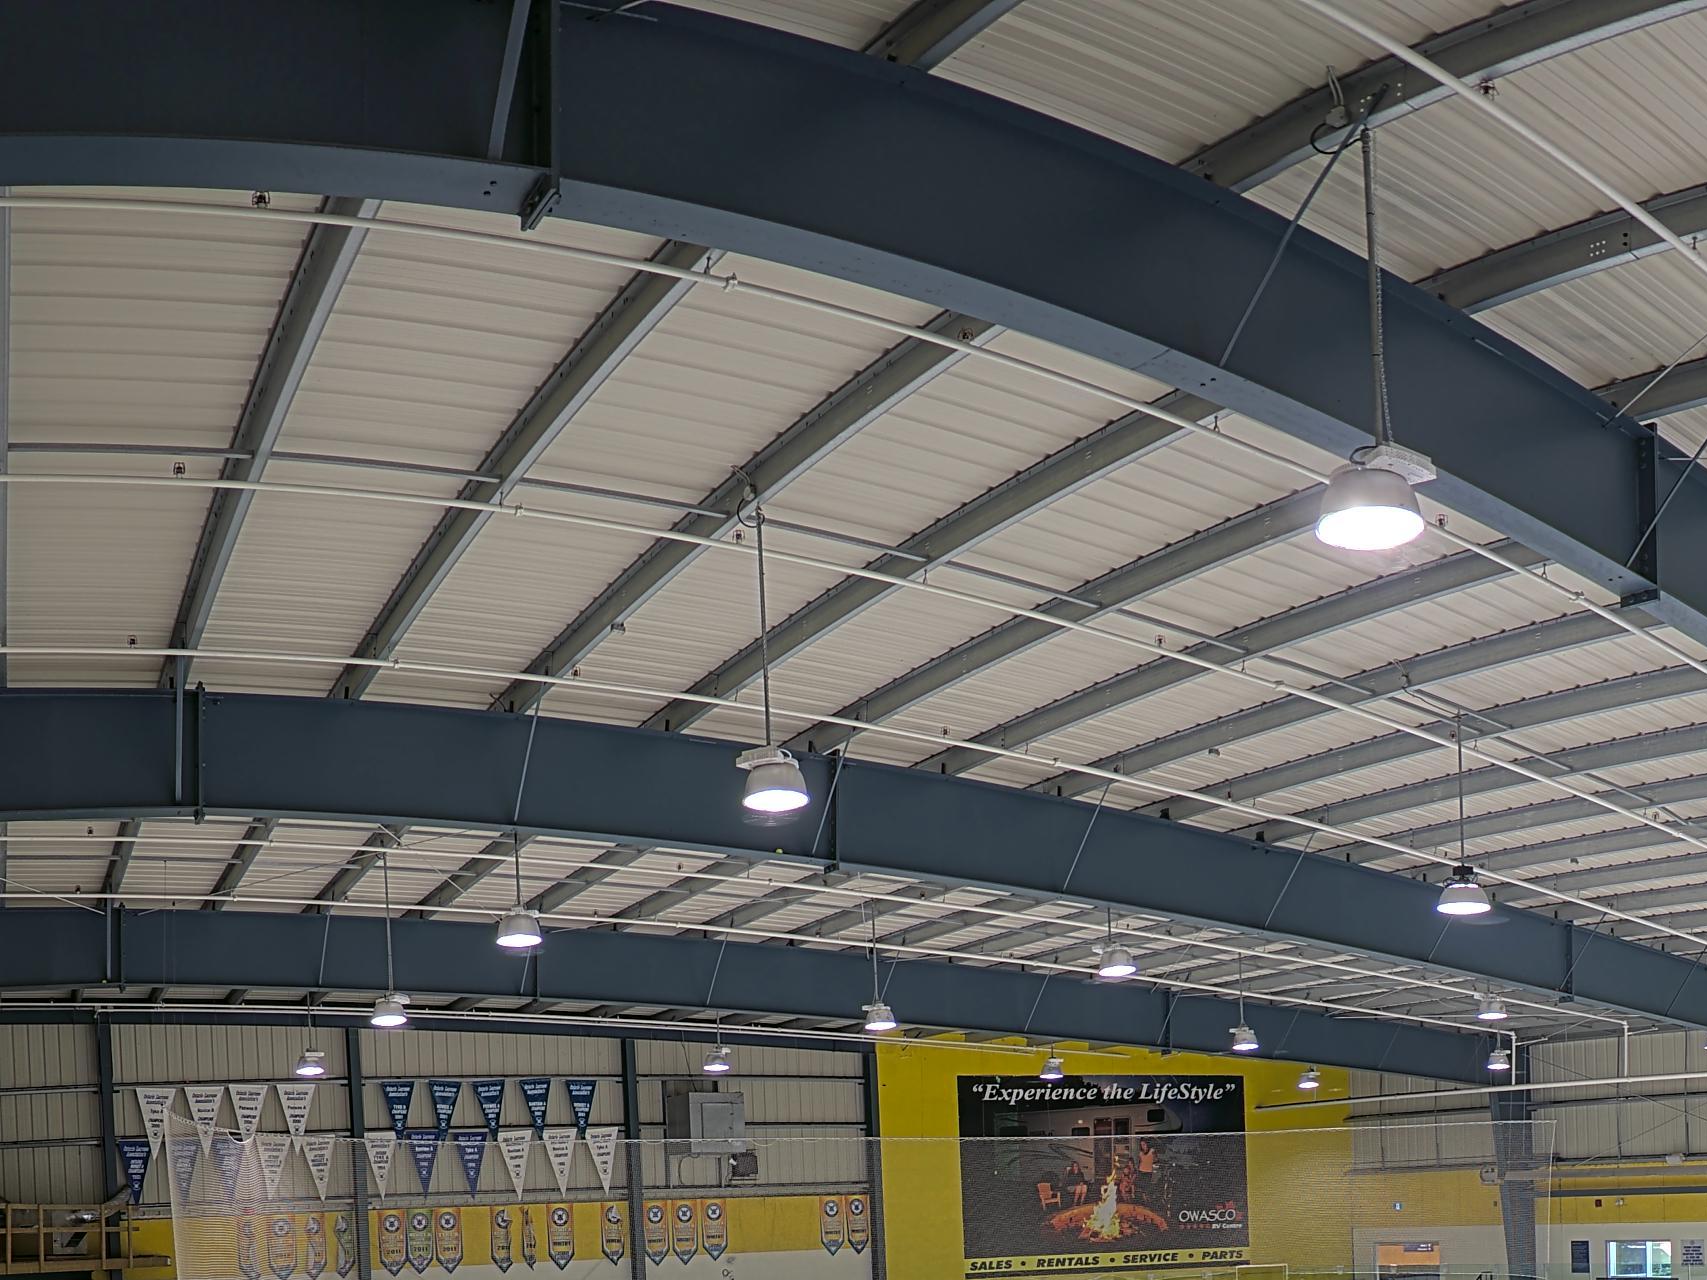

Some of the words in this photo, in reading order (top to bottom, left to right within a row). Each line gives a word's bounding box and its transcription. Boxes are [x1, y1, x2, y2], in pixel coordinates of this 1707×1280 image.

[972, 1083, 1098, 1105] “Experience
[1103, 1084, 1134, 1100] the
[1138, 1083, 1236, 1105] LifeStyle”
[1178, 1208, 1236, 1223] OWASCO
[969, 1260, 1013, 1271] SALES
[1036, 1256, 1100, 1268] RENTALS
[1122, 1252, 1179, 1264] SERVICE
[1201, 1249, 1243, 1261] PARTS
